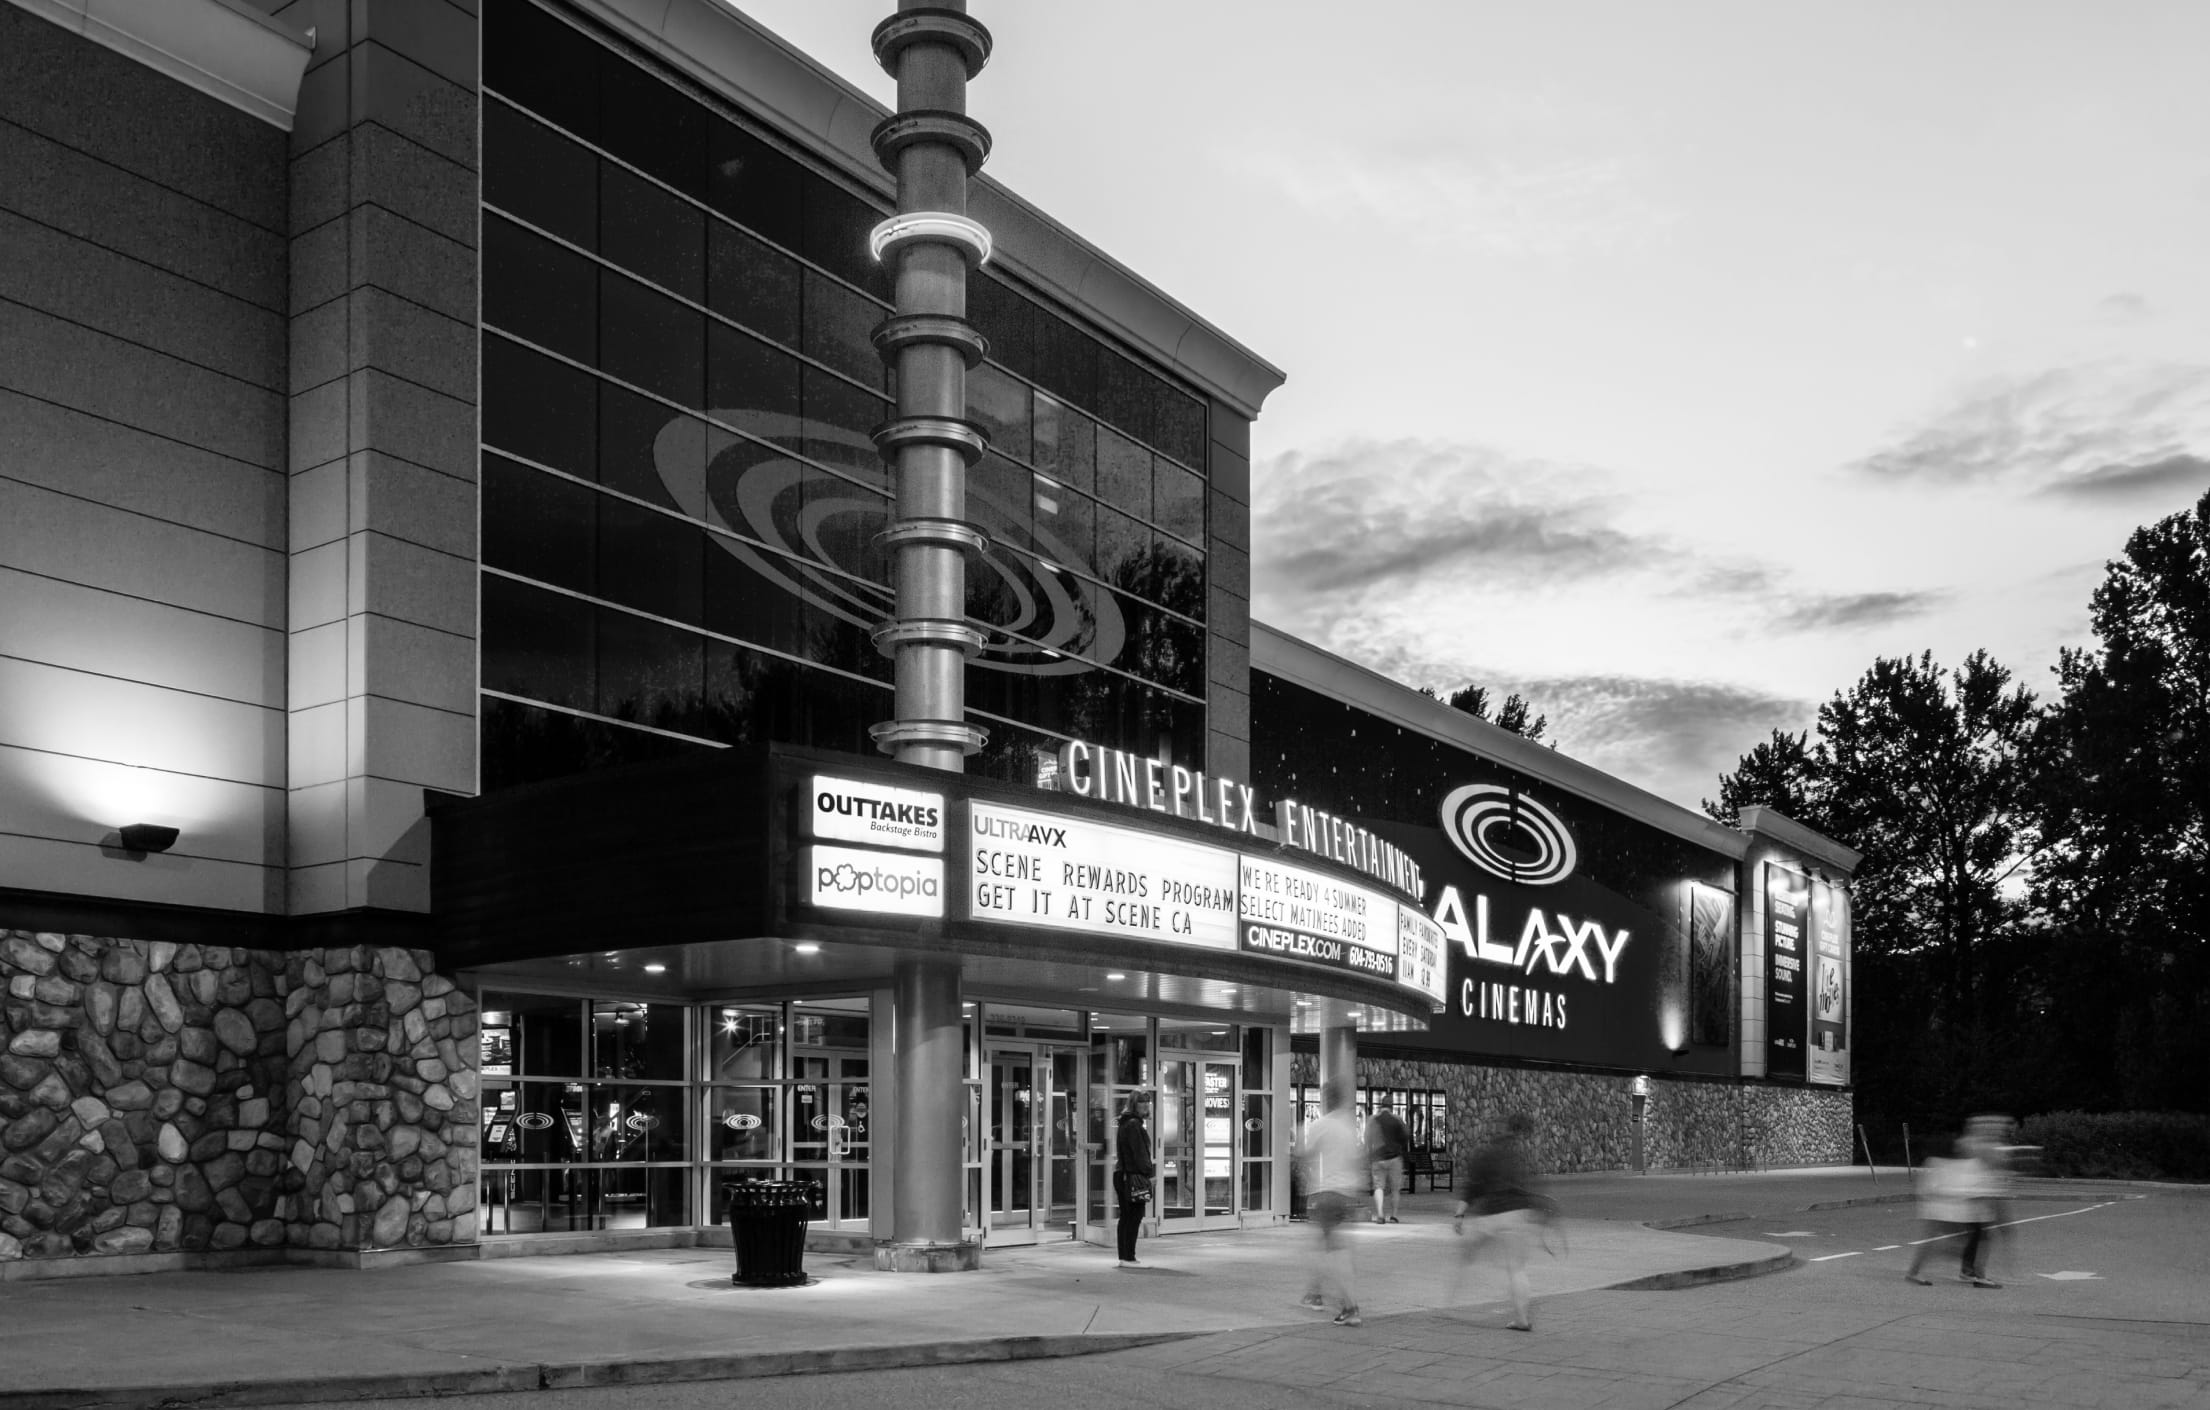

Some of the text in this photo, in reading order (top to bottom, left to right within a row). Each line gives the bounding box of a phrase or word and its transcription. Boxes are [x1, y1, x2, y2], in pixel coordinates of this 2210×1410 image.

[817, 792, 938, 827] OUTTAKES
[870, 821, 937, 839] Backstage Bistro
[1069, 739, 1422, 902] CINEPLEX ENTERTAINMENT
[976, 849, 1233, 912] SCENE REWARDS PROGRAM
[1285, 876, 1319, 903] READY
[1324, 887, 1330, 906] 4
[1333, 889, 1367, 917] SUMMER
[978, 883, 1192, 935] GET IT AT SCENE CA
[1240, 894, 1367, 942] SELECT MATINEES ADDED
[1249, 926, 1341, 960] CINEPLEX.COM
[1402, 936, 1418, 958] EVERY
[1432, 884, 1630, 984] ALAXY
[1462, 978, 1566, 1029] CINEMAS
[797, 1084, 816, 1092] ENTER
